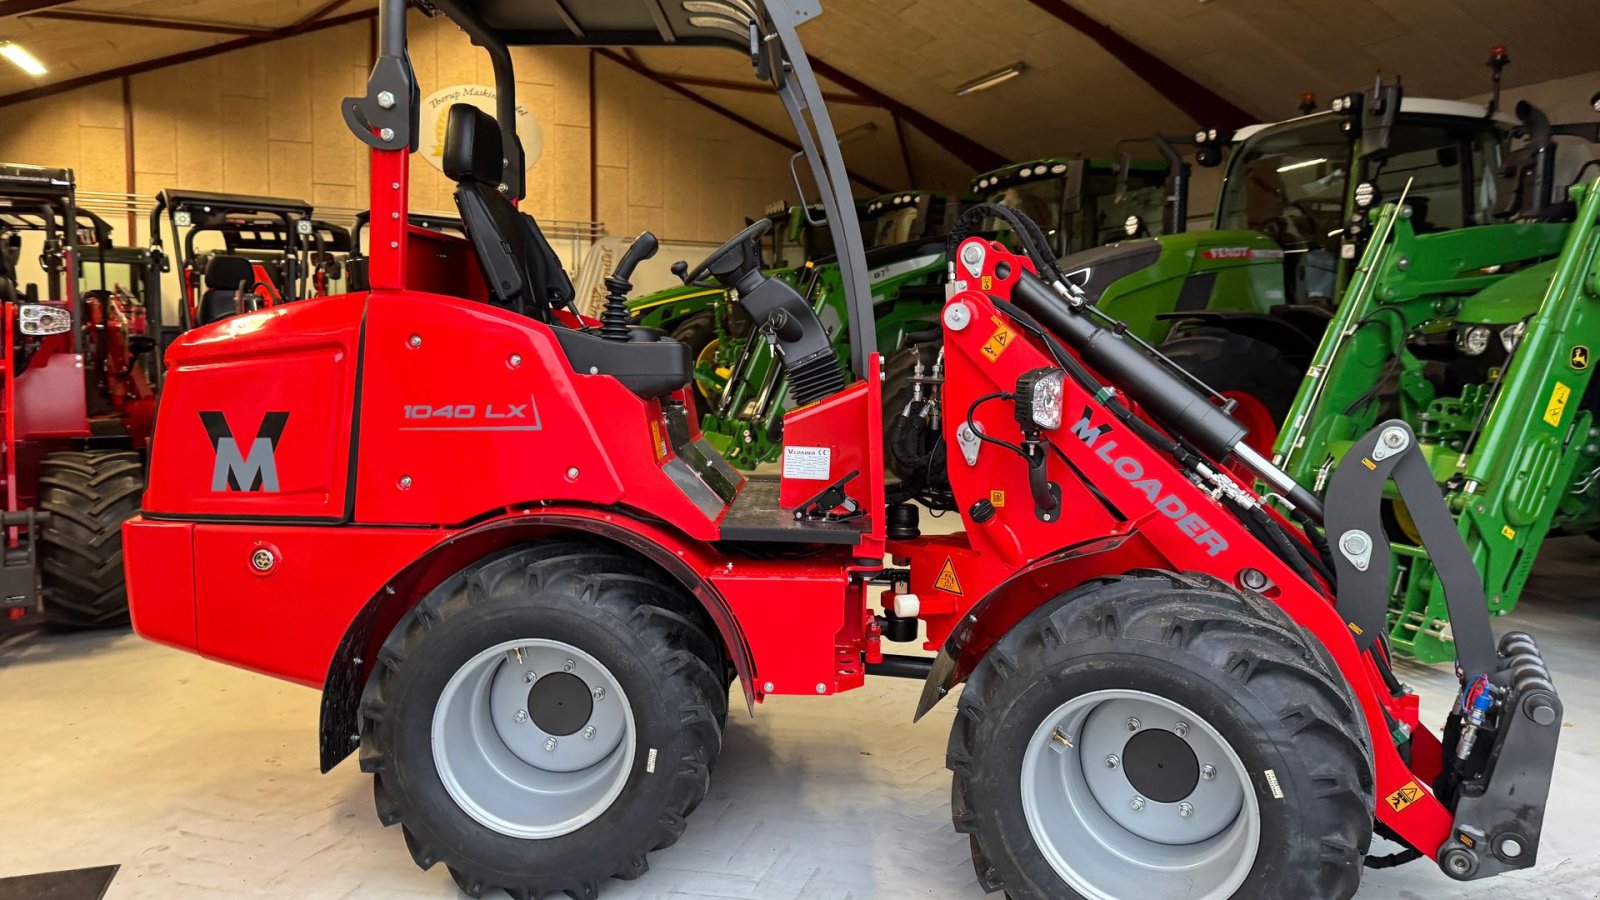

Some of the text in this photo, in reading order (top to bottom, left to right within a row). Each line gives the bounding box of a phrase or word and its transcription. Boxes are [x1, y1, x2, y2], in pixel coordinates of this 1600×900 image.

[429, 91, 461, 109] Thorup
[1211, 247, 1249, 258] FENDT
[403, 404, 528, 419] 1040 LX
[1094, 440, 1229, 557] LOADER
